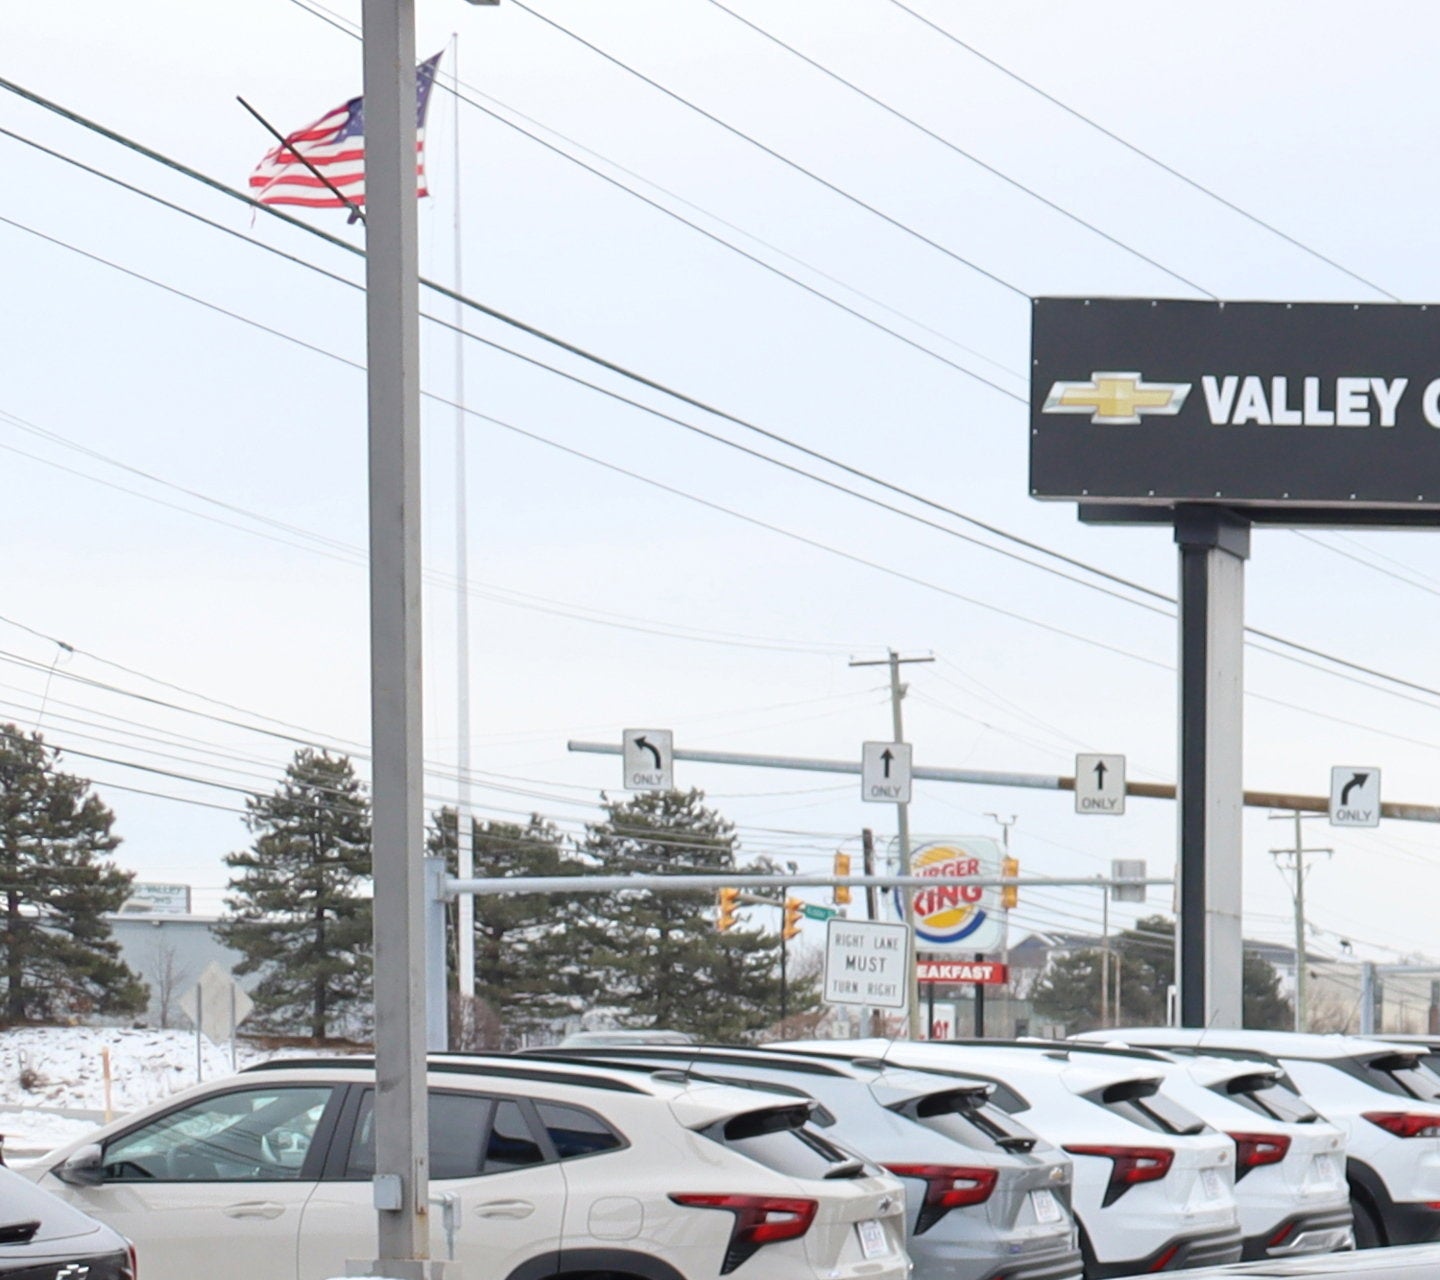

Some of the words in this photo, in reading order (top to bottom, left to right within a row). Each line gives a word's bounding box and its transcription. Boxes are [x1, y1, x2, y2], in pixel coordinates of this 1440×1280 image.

[1202, 375, 1408, 427] VALLEY
[633, 772, 664, 786] ONLY
[871, 785, 901, 799] ONLY
[1081, 797, 1117, 810] ONLY
[1336, 808, 1371, 823] ONLY
[835, 933, 864, 948] RIGHT
[873, 937, 899, 951] LANE
[845, 955, 887, 973] MUST
[916, 964, 993, 980] EAKFAST
[833, 980, 858, 993] TURN
[867, 982, 897, 997] RIGHT
